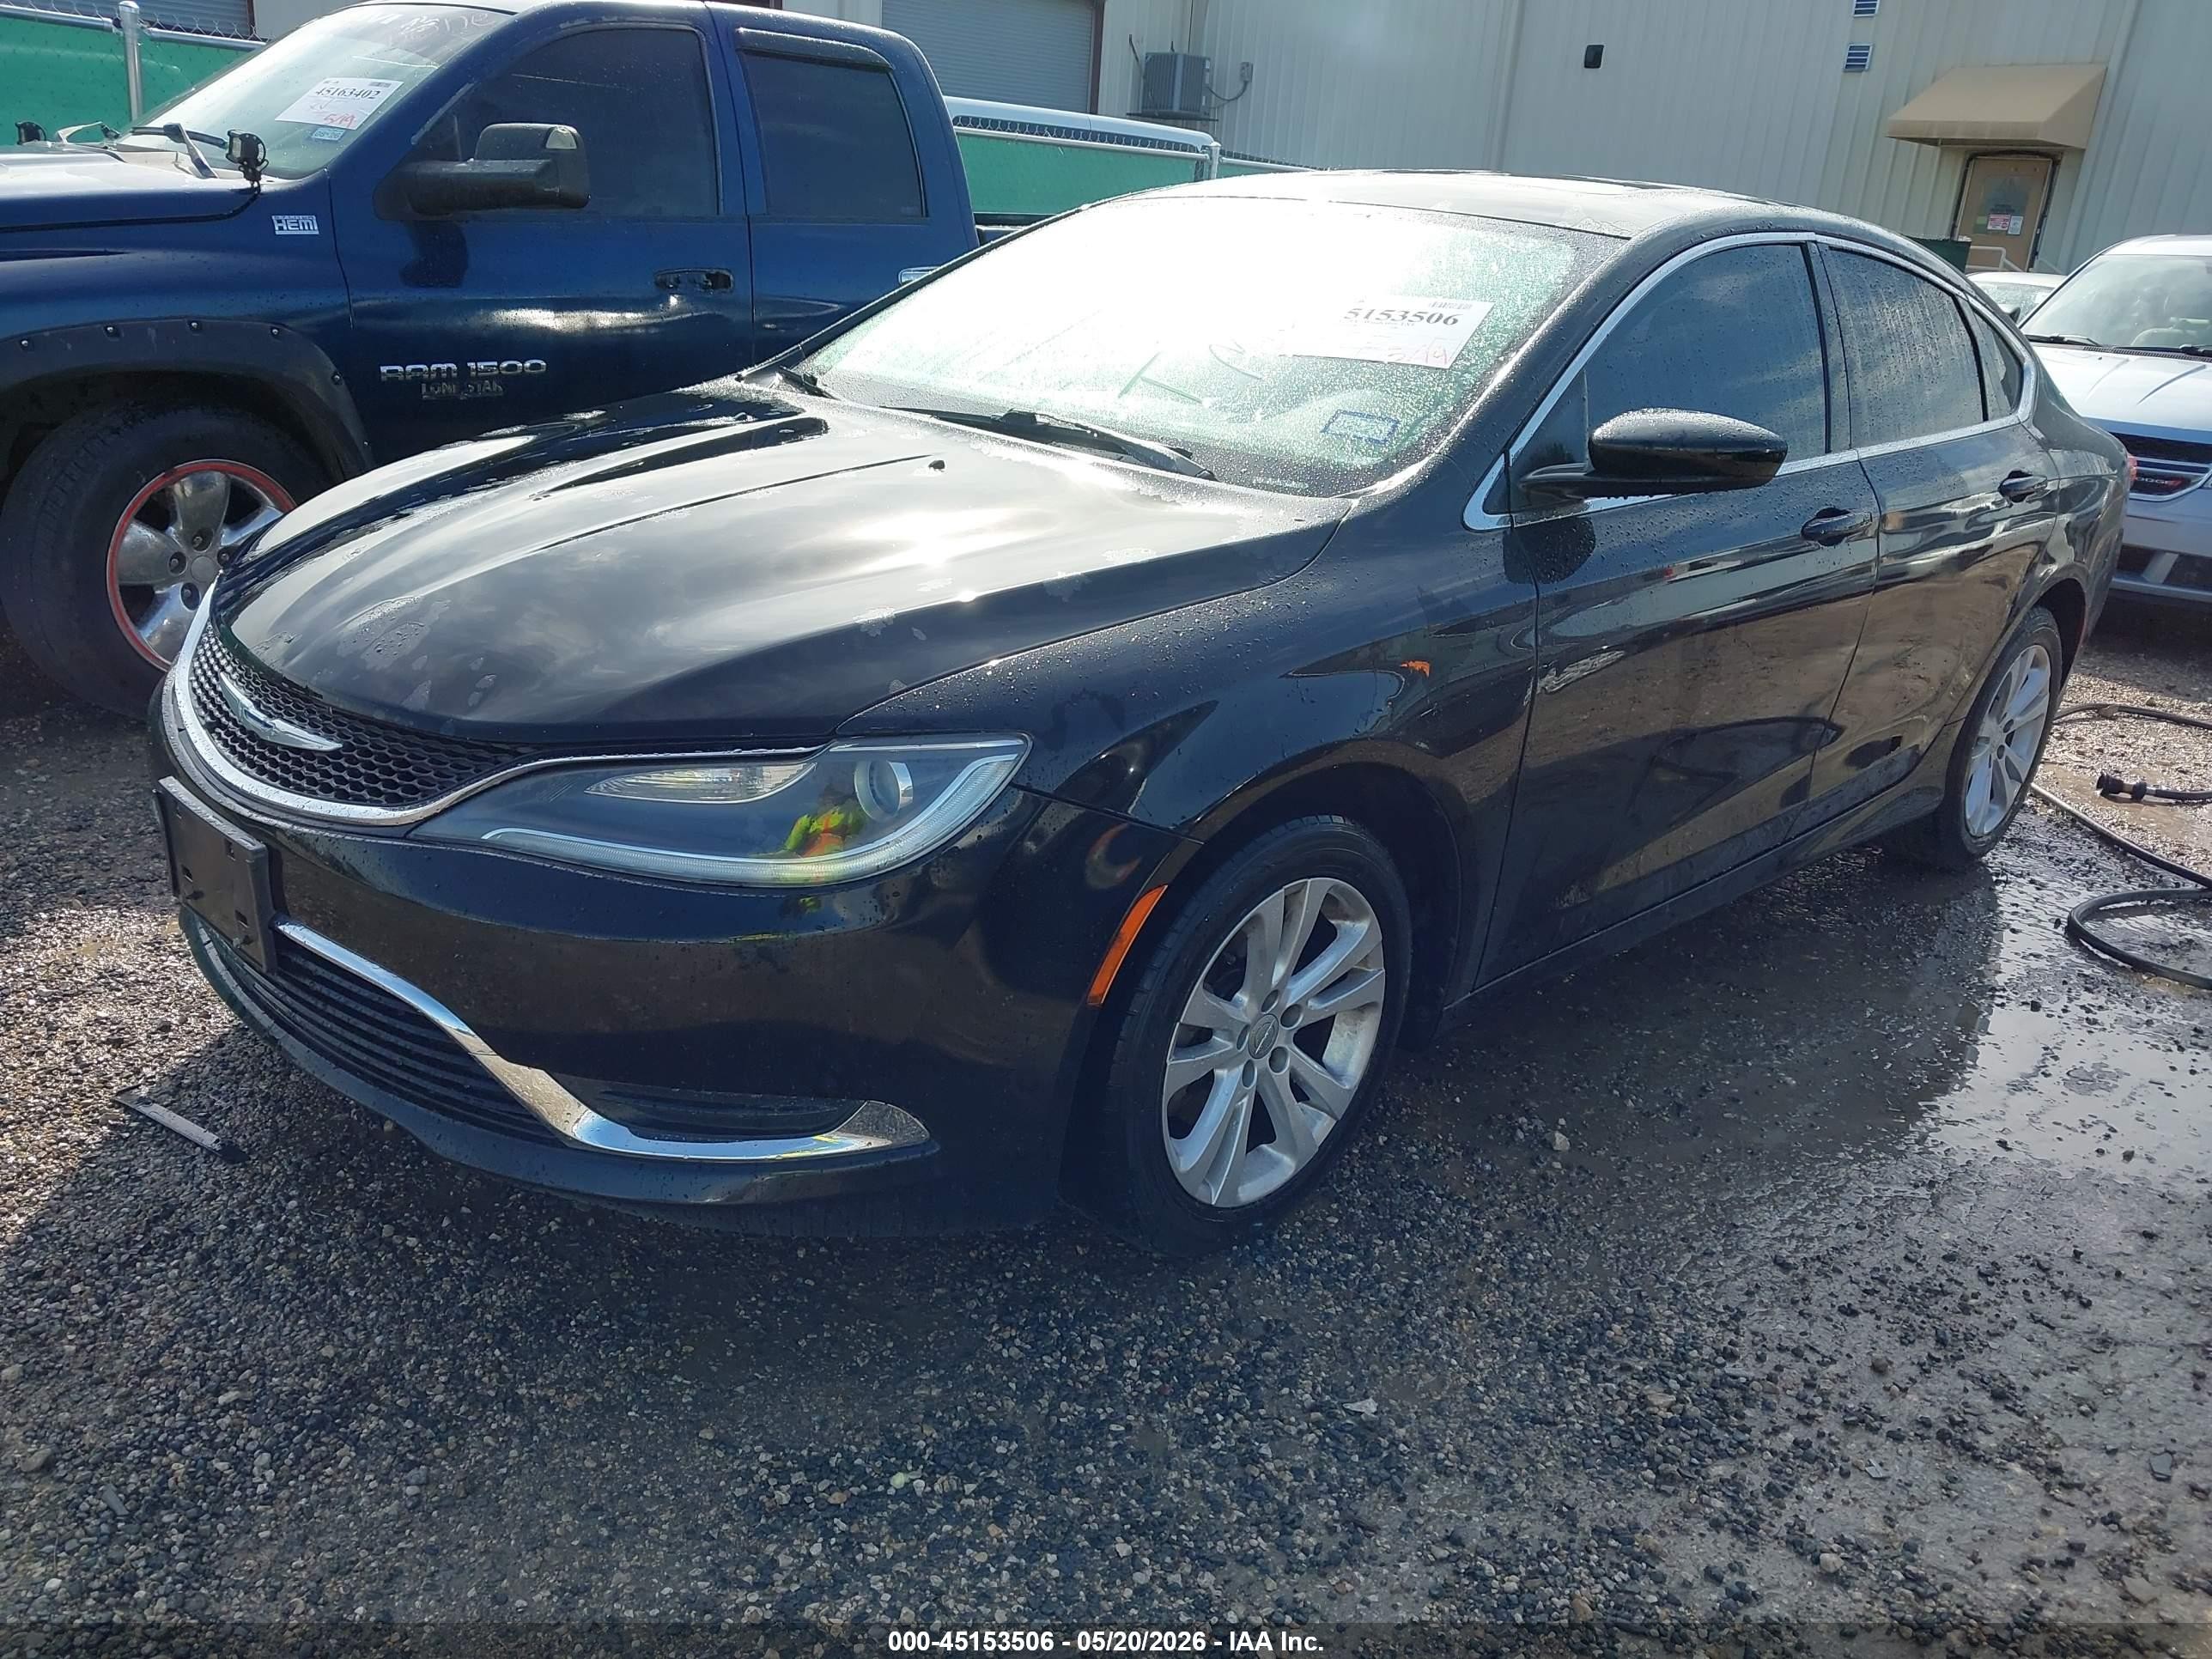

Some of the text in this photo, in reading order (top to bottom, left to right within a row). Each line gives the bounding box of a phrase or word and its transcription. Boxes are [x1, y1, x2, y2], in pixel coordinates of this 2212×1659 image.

[316, 87, 380, 100] 45163402
[273, 219, 318, 231] HEMI
[380, 359, 547, 381] RAM 1500
